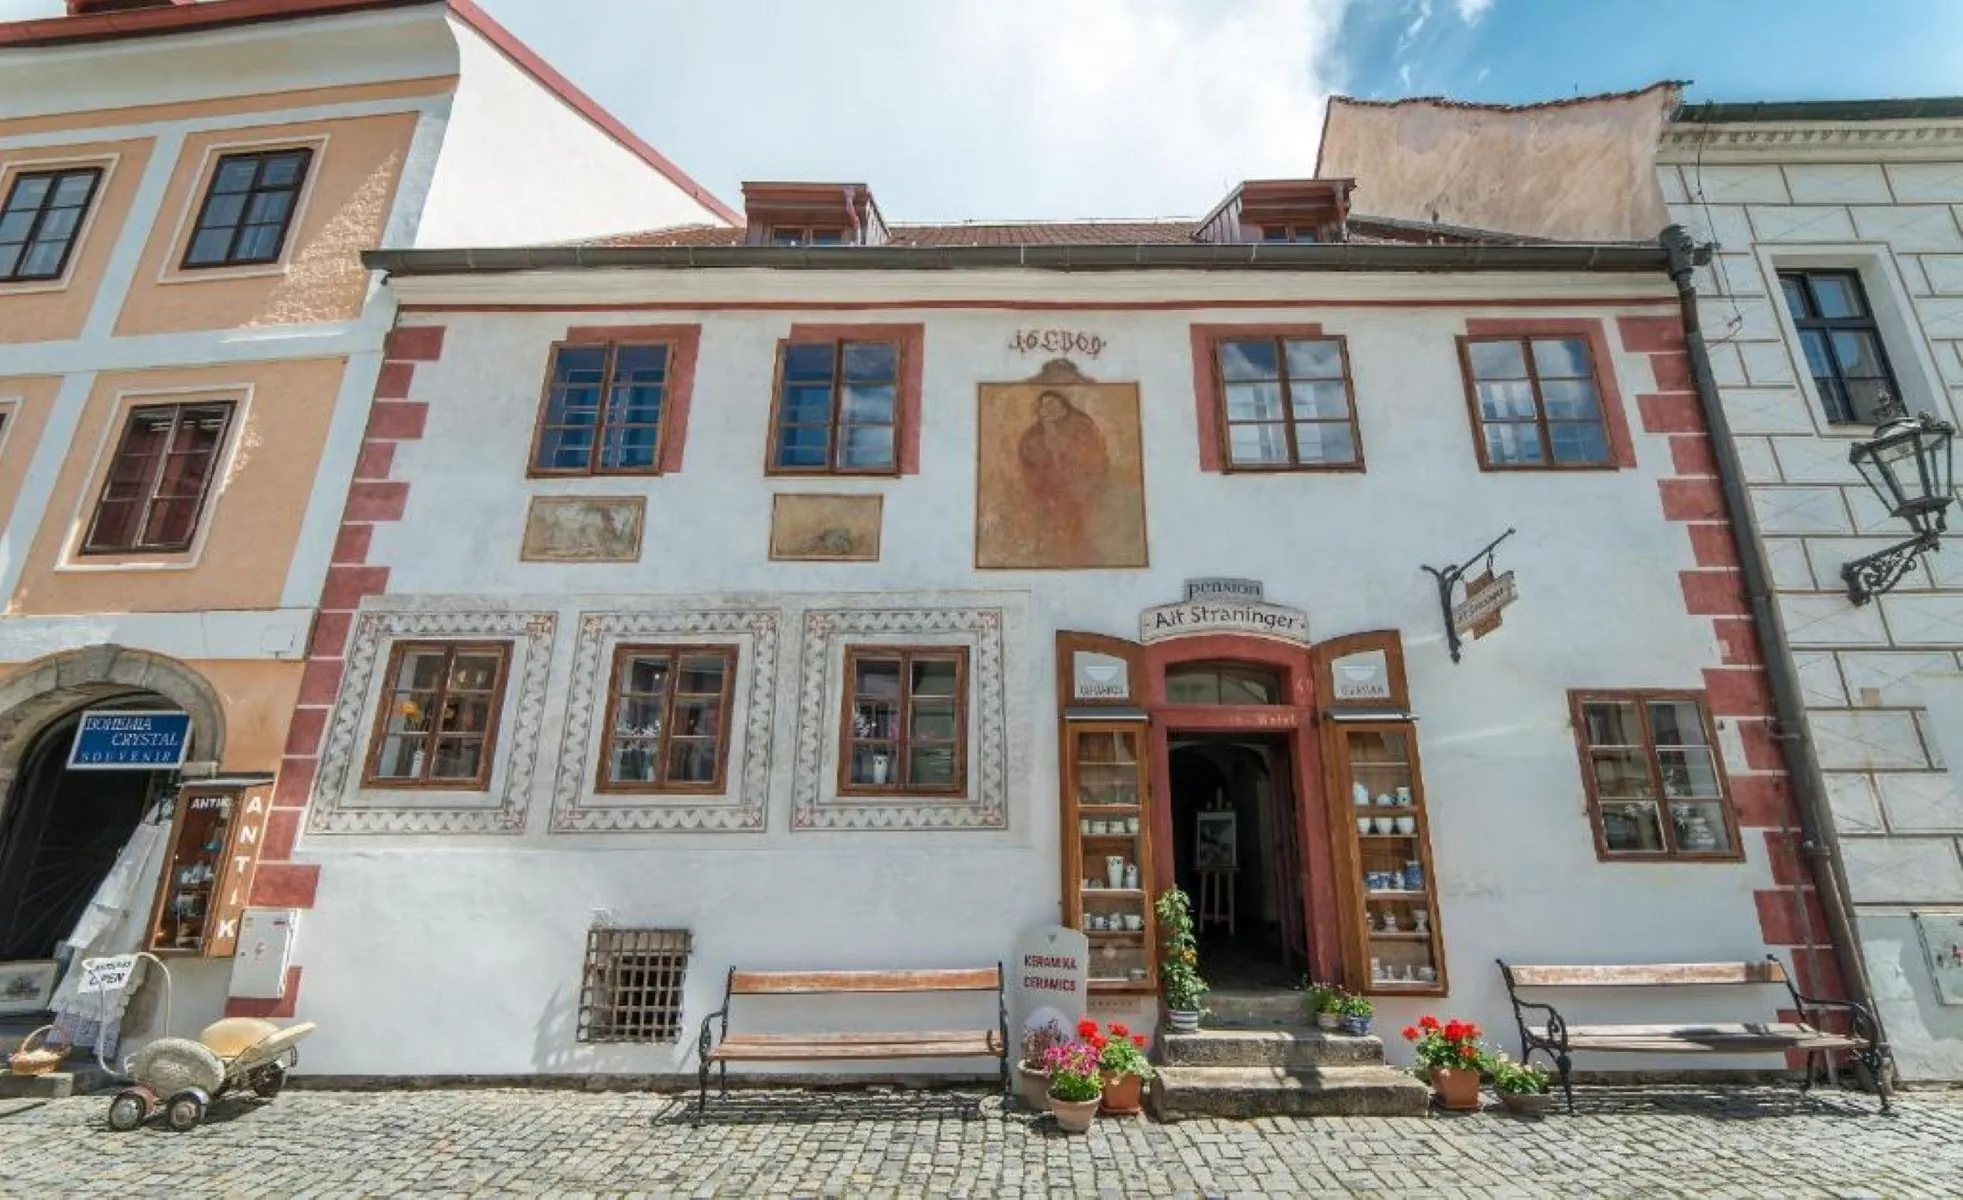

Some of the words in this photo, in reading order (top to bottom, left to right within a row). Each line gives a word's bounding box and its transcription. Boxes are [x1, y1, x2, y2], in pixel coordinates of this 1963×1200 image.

[1189, 582, 1260, 599] pension
[1191, 605, 1299, 629] Straninger
[85, 718, 152, 730] BOHEMIA
[112, 733, 178, 746] CRYSTAL
[82, 751, 171, 761] SOUVENIR
[190, 797, 231, 810] ANTIK
[217, 796, 262, 938] ANTIK
[1024, 954, 1077, 970] KERAMIKA
[1024, 976, 1076, 991] CERAMICS
